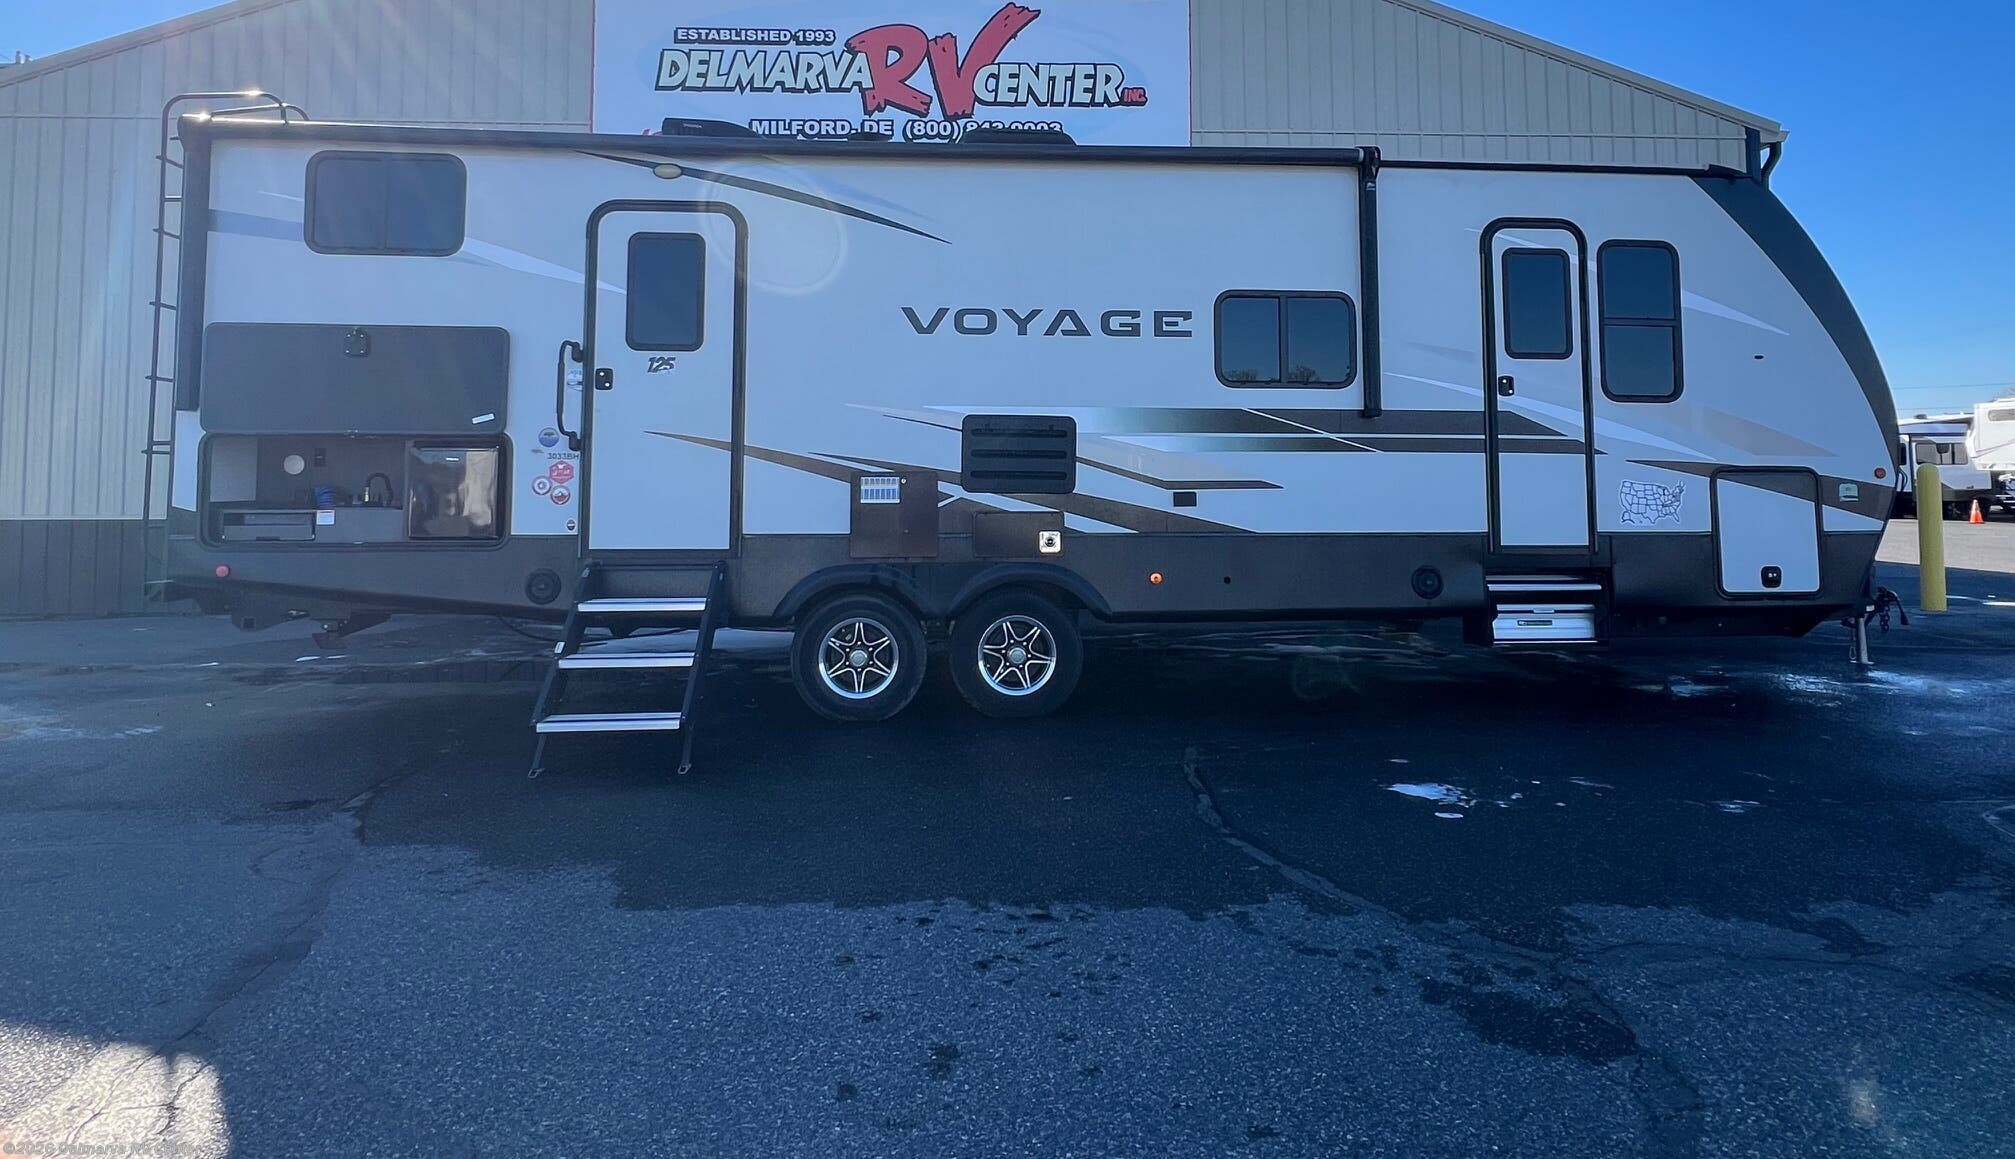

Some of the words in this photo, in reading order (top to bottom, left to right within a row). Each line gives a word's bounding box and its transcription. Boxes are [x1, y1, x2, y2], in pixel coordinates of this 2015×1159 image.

[676, 28, 791, 43] ESTABLISHED
[795, 31, 836, 43] 1993
[656, 49, 874, 92] DELMARVA
[845, 2, 1041, 119] RV
[973, 63, 1124, 106] CENTER
[863, 120, 892, 135] DE
[904, 120, 959, 140] (800)
[901, 306, 1193, 338] VOYAGE
[647, 356, 676, 373] 125
